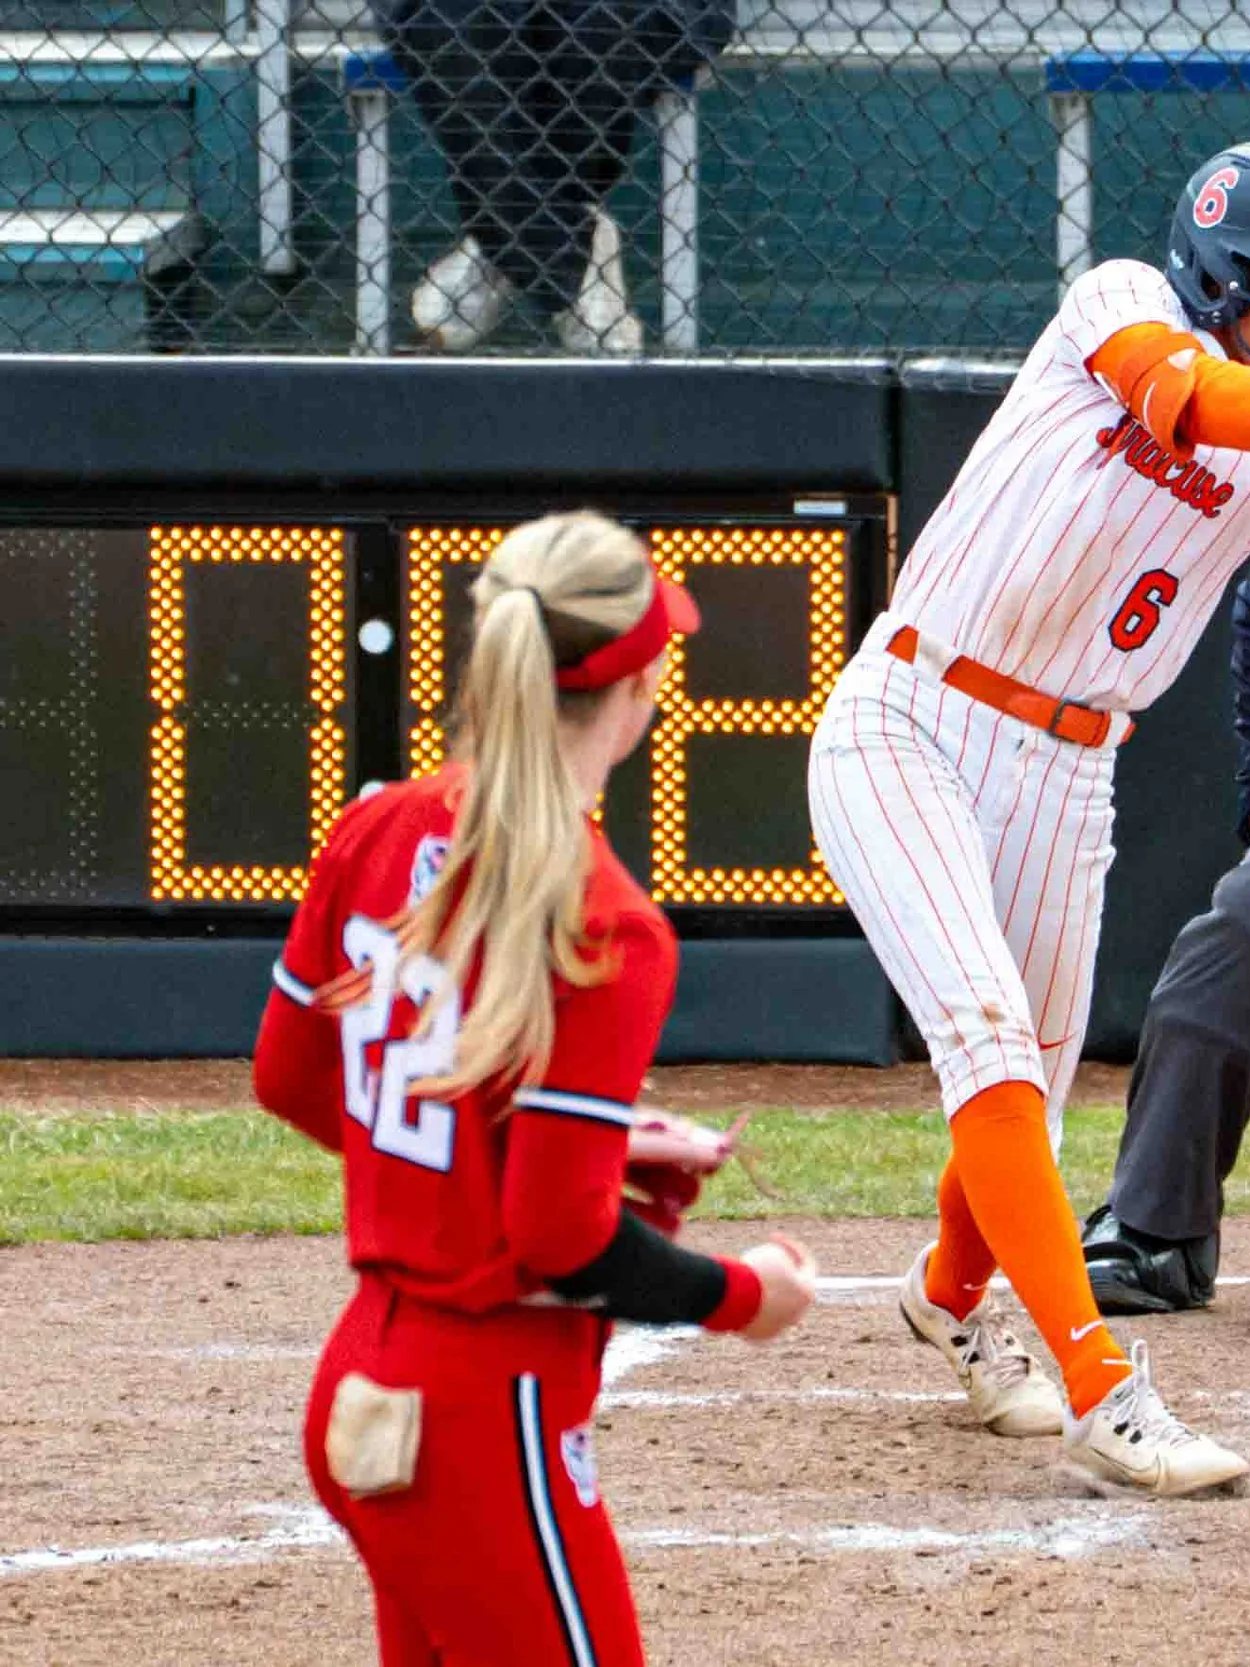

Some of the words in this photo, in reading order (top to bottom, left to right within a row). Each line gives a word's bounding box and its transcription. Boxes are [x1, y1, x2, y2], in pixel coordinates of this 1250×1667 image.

[1193, 167, 1240, 229] 6
[1108, 568, 1179, 653] 6
[341, 915, 461, 1174] 22
